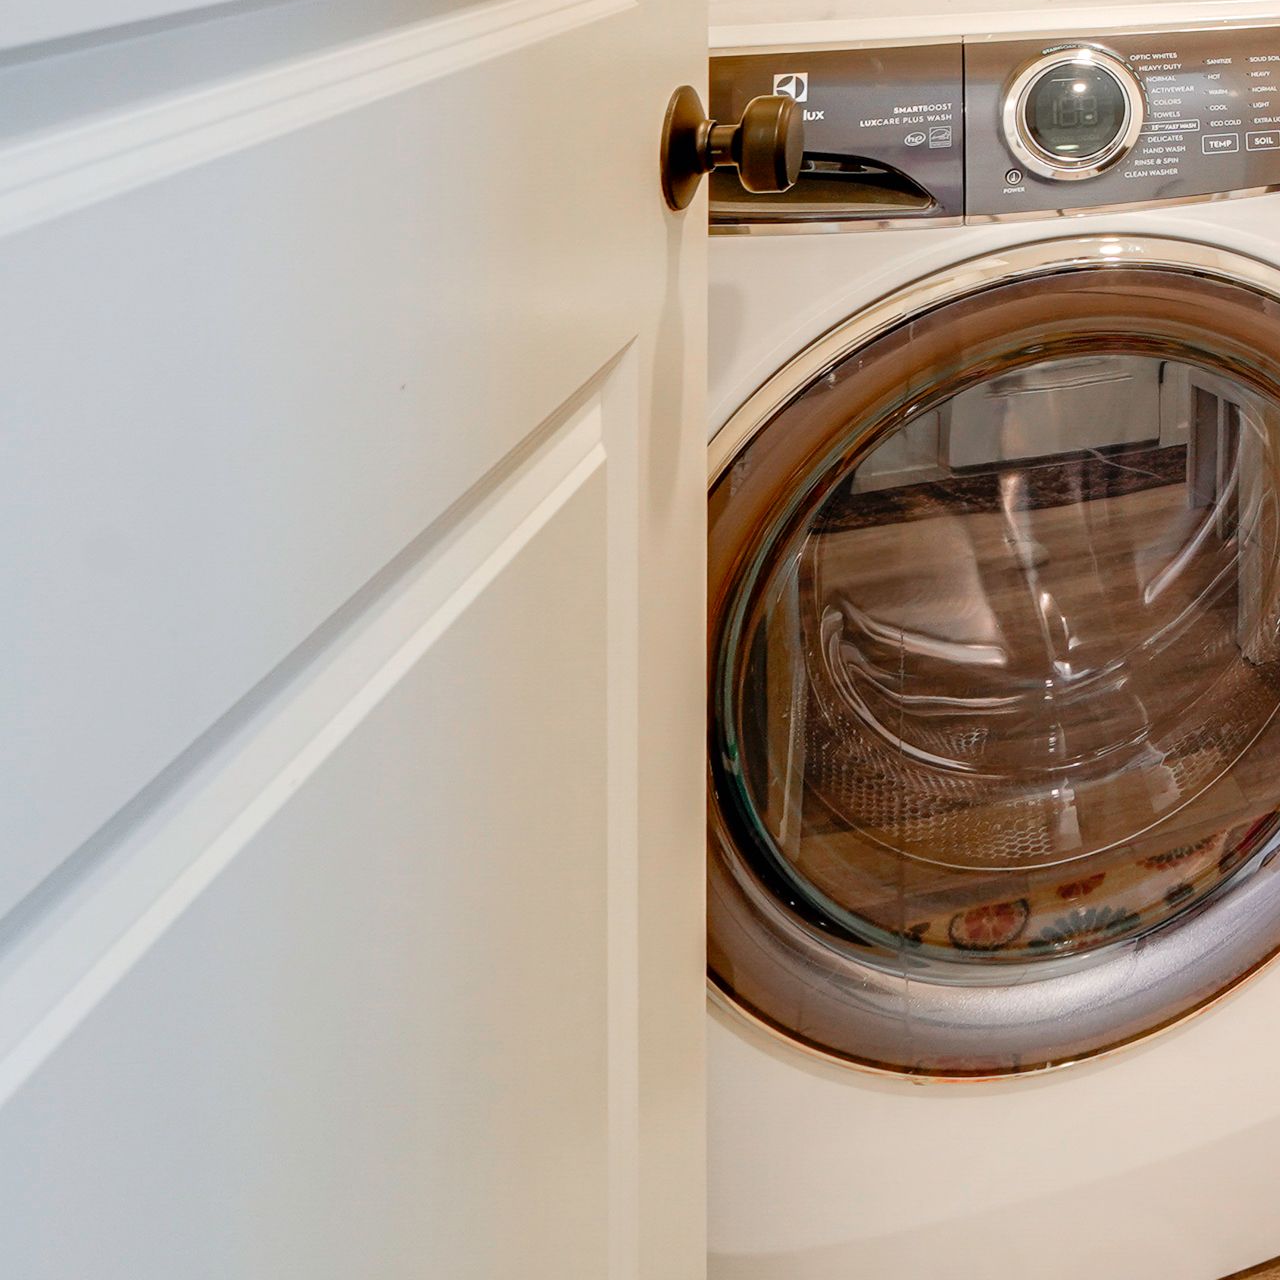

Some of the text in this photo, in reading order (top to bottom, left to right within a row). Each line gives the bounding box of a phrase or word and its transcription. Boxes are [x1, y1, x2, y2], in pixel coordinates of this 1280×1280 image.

[1152, 52, 1178, 60] WHITES
[1163, 63, 1182, 71] DUTY
[1151, 86, 1194, 94] ACTIVEWEAR
[1153, 98, 1182, 106] COLORS
[893, 103, 952, 114] SMARTBOOST
[859, 113, 953, 127] LUXCARE PLUS WASH
[1180, 121, 1197, 129] WASH
[1147, 135, 1184, 143] DELICATES
[1254, 136, 1274, 145] SOIL
[1209, 140, 1233, 149] TEMP
[1149, 168, 1178, 176] WASHER
[1003, 186, 1025, 194] POWER
